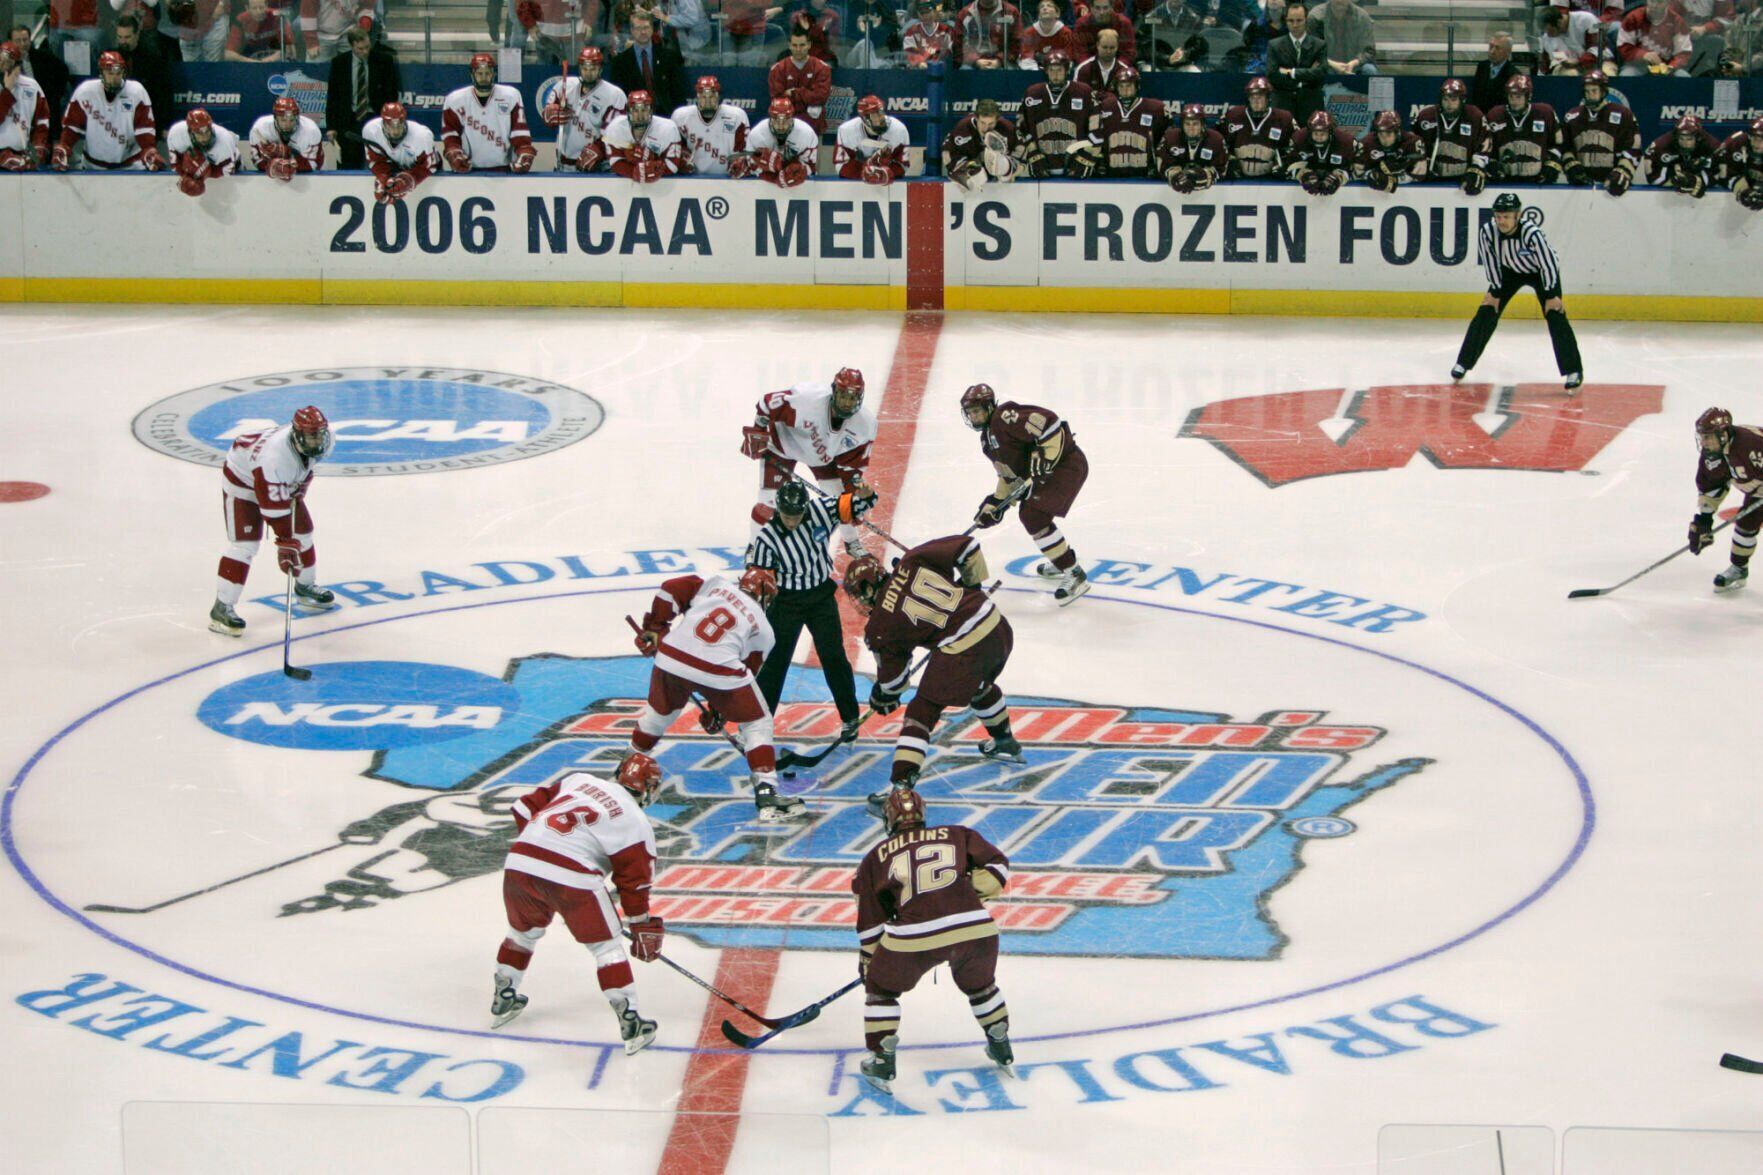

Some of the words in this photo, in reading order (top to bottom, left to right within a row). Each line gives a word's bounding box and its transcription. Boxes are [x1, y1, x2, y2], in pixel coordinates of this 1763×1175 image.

[329, 195, 497, 254] 2006
[755, 199, 903, 259] MEN
[1043, 203, 1306, 264] FROZEN
[151, 412, 224, 463] CELEBRATIN
[881, 563, 910, 614] BOYLE
[902, 566, 964, 630] 10
[1004, 554, 1428, 634] CENTER
[694, 606, 737, 644] 8
[224, 702, 502, 729] NCAA
[575, 782, 625, 820] BURISH
[877, 827, 949, 863] COLLINS
[888, 843, 958, 907] 12
[15, 972, 525, 1103] CENTER
[825, 993, 1499, 1119] BRADLEY
